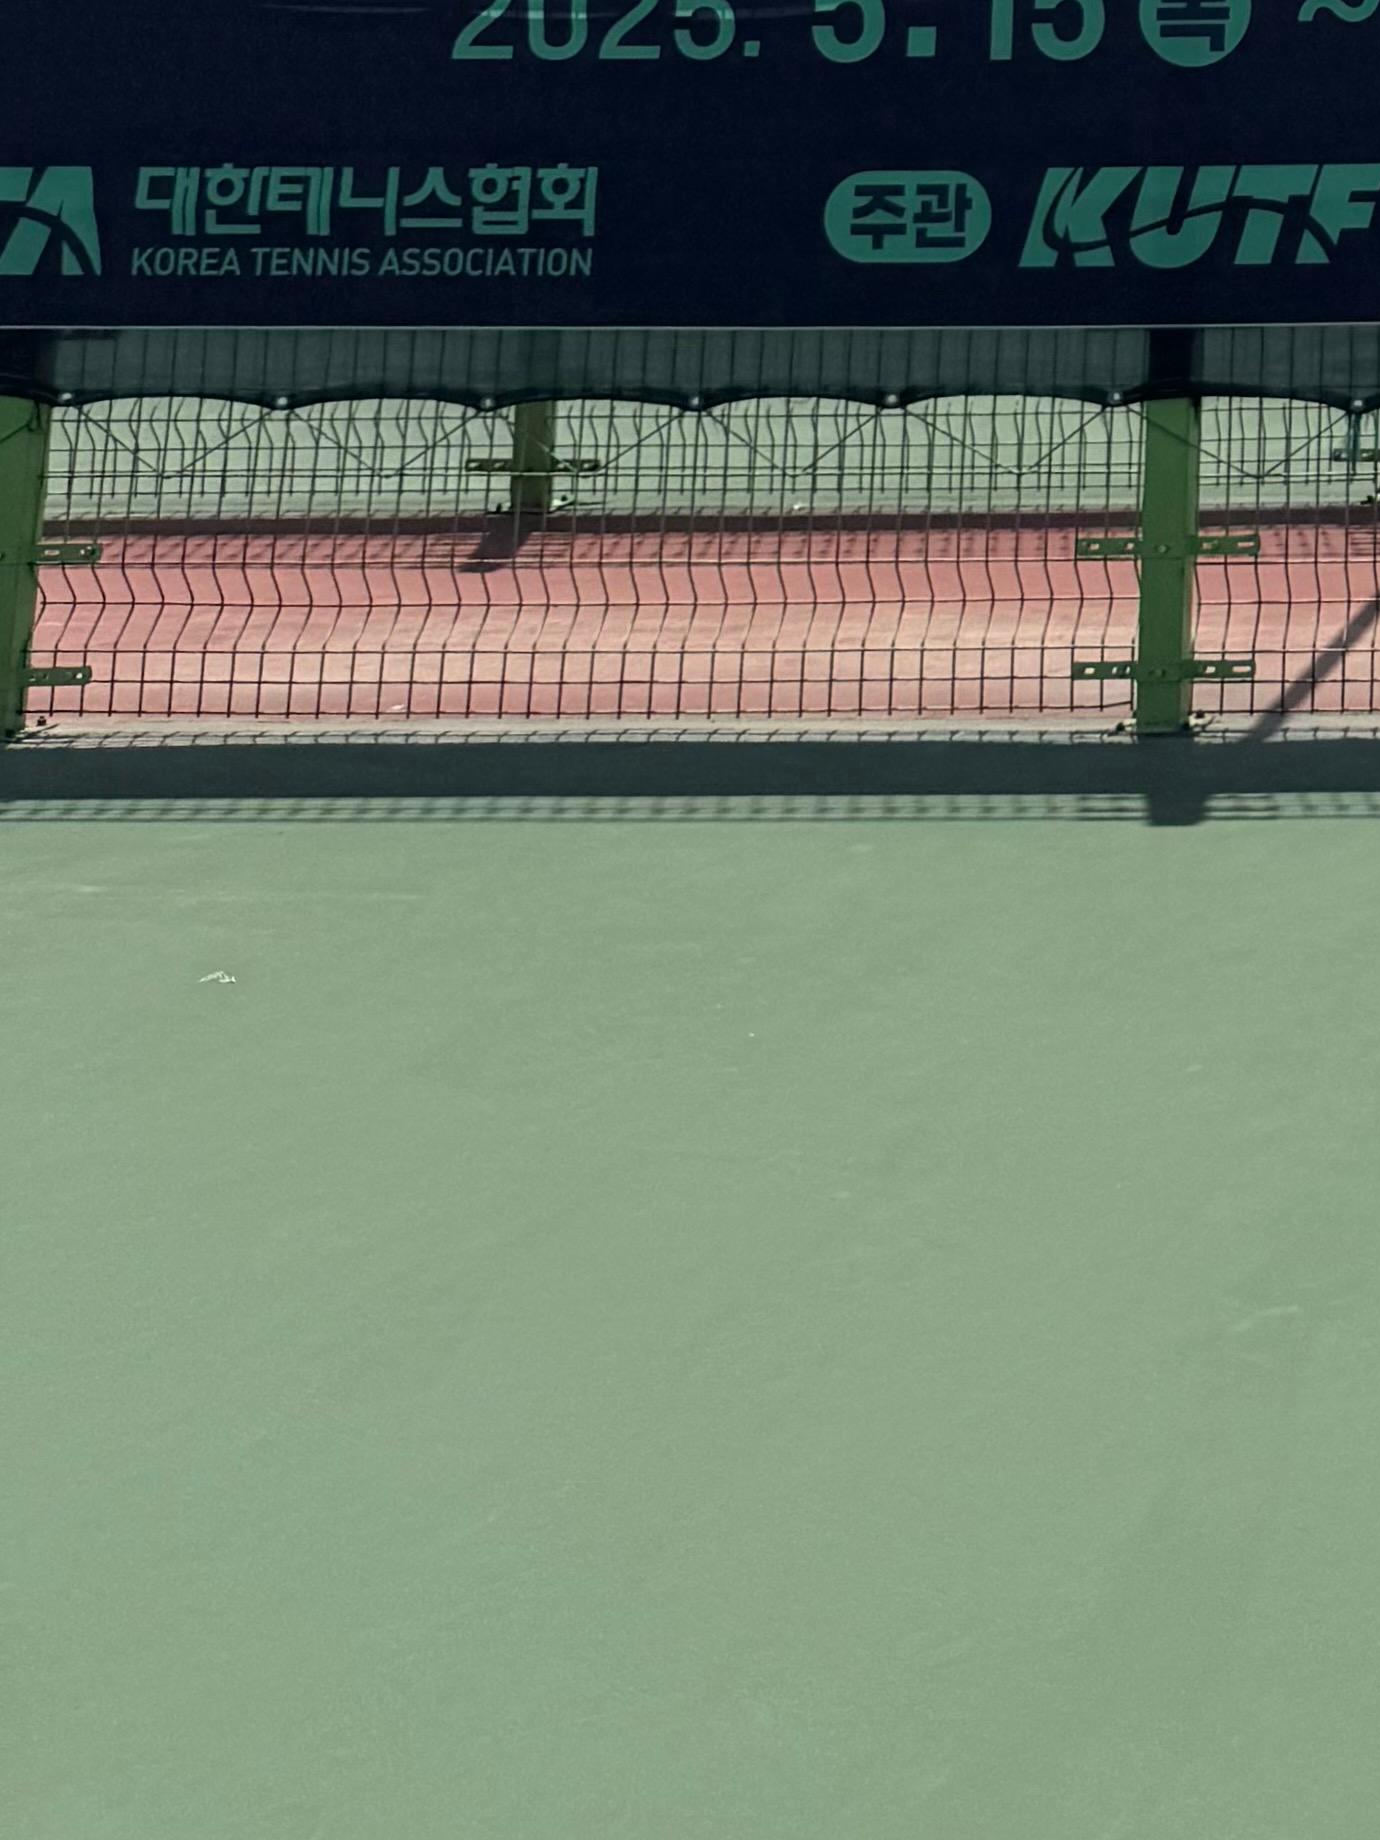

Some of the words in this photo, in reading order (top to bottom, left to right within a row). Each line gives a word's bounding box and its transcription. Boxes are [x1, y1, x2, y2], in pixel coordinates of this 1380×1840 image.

[134, 162, 599, 236] 대한테니스협회
[849, 184, 973, 251] 주관
[131, 247, 241, 276] KOREA
[250, 247, 371, 276] TENNIS
[378, 246, 594, 276] ASSOCIATION
